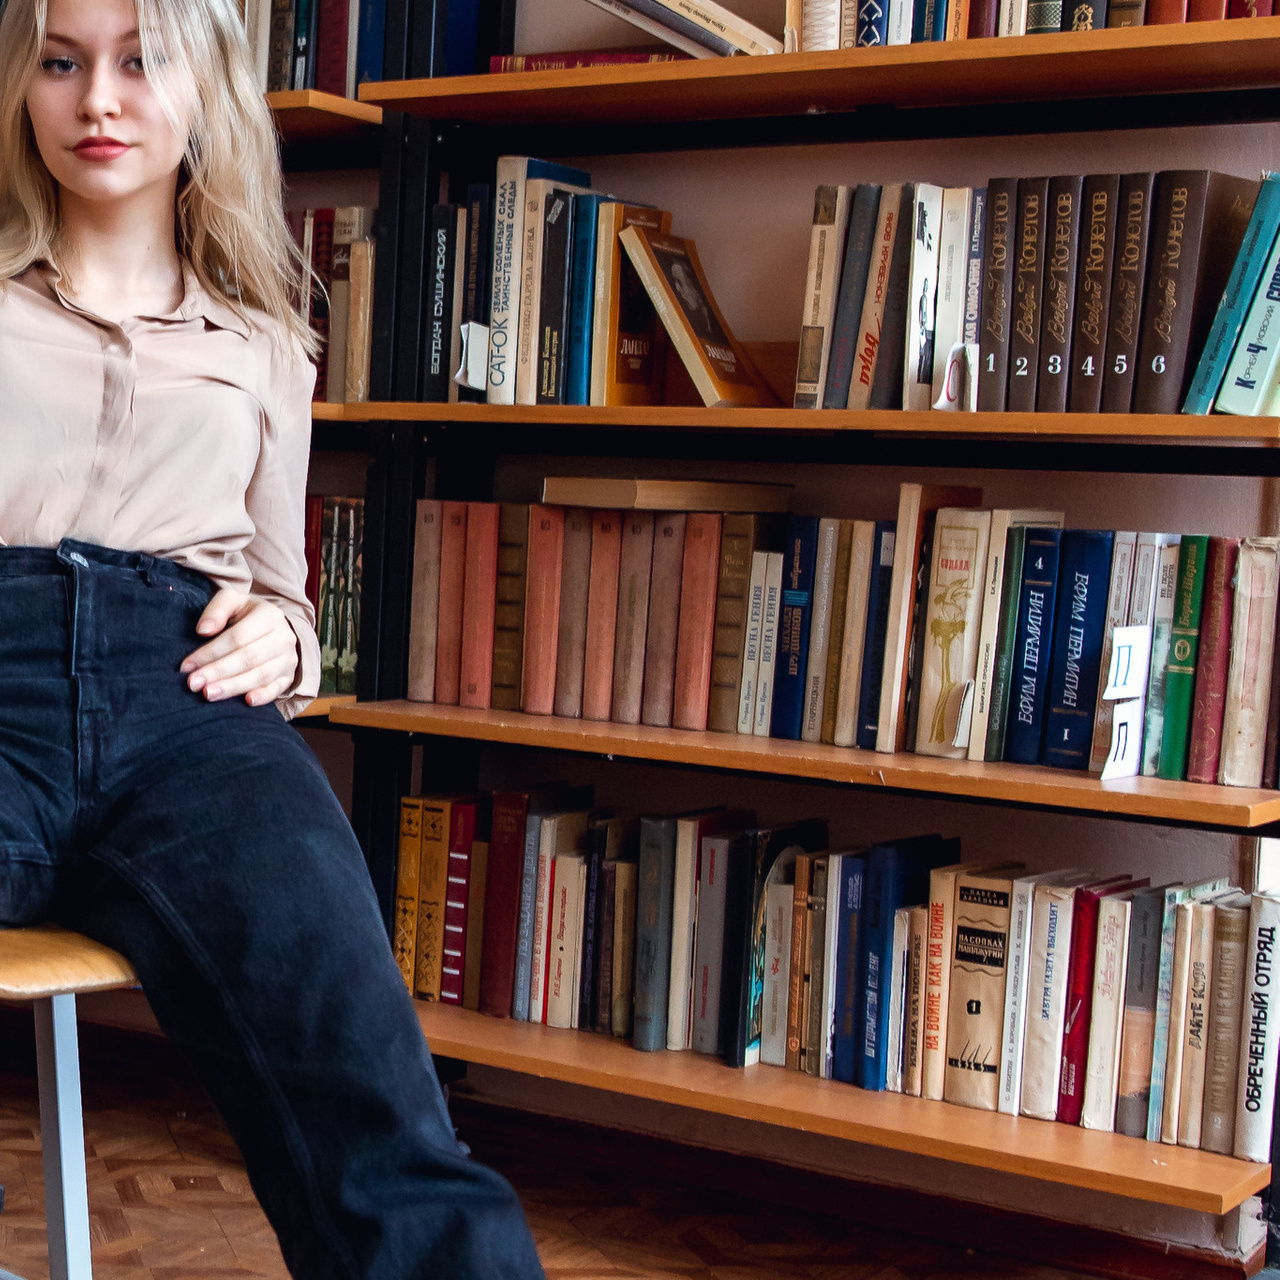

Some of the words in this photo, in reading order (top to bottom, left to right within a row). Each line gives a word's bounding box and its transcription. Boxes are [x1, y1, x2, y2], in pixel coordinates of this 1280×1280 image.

[498, 181, 507, 214] СКАЛ
[507, 180, 517, 220] СЛЕДЫ
[495, 220, 505, 273] СОЛЕНЫХ
[525, 226, 535, 261] ЛОРКА
[882, 212, 894, 241] ЯКОВ
[989, 193, 1009, 270] Кочетов
[1018, 194, 1039, 273] Кочетов
[1051, 193, 1072, 272] Кочетов
[1085, 191, 1108, 272] Кочетов
[1120, 190, 1144, 272] Кочетов
[1160, 187, 1188, 269] Кочетов
[434, 228, 447, 317] СУШИНСКИЙ
[501, 223, 514, 313] ТАИНСТВЕННЫЕ
[492, 276, 502, 313] ЗЕМЛЯ
[430, 321, 441, 374] БОГДАН
[490, 318, 508, 387] САТ-ОК
[520, 309, 532, 365] ФЕДЕРИКО
[964, 322, 977, 343] КАЯ
[987, 353, 995, 372] 1
[1016, 357, 1028, 376] 2
[1048, 355, 1062, 374] 3
[1081, 356, 1095, 376] 4
[1114, 354, 1127, 374] 5
[1152, 355, 1165, 374] 6
[792, 538, 802, 589] избранное
[1035, 556, 1043, 570] 4
[1182, 544, 1197, 590] Шергин
[751, 585, 762, 623] ГЕНИЯ
[766, 586, 778, 624] ГЕНИЯ
[1072, 571, 1089, 622] ЕФИМ
[1179, 592, 1193, 627] Борис
[747, 627, 759, 661] ВЕСНА
[762, 629, 773, 663] ВЕСНА
[789, 608, 802, 675] ПРУДНИКОВ
[1024, 590, 1044, 672] ПЕРМИТИН
[1062, 626, 1084, 707] ПЕРМИТИН
[1112, 645, 1132, 688] П
[1018, 675, 1036, 725] ЕФИМ
[1113, 722, 1128, 762] П
[929, 902, 944, 939] ВОЙНЕ
[1046, 902, 1058, 949] ВЫХОДИТ
[929, 943, 943, 957] НА
[959, 934, 968, 944] НА
[970, 936, 1003, 948] СОПКАХ
[1255, 926, 1275, 987] ОТРЯД
[913, 934, 921, 995] ПОВЕРКЕ
[927, 963, 942, 987] КАК
[1044, 952, 1054, 984] ГАЗЕТА
[912, 998, 920, 1016] НА
[926, 993, 941, 1031] ВОЙНЕ
[972, 1002, 976, 1013] 1
[1042, 986, 1052, 1021] ЗАВТРА
[909, 1019, 919, 1067] ИМЕНА
[926, 1035, 939, 1050] НА
[1188, 1002, 1203, 1049] ДАЙТЕ
[1245, 992, 1268, 1113] ОБРЕЧЕННЫЙ
